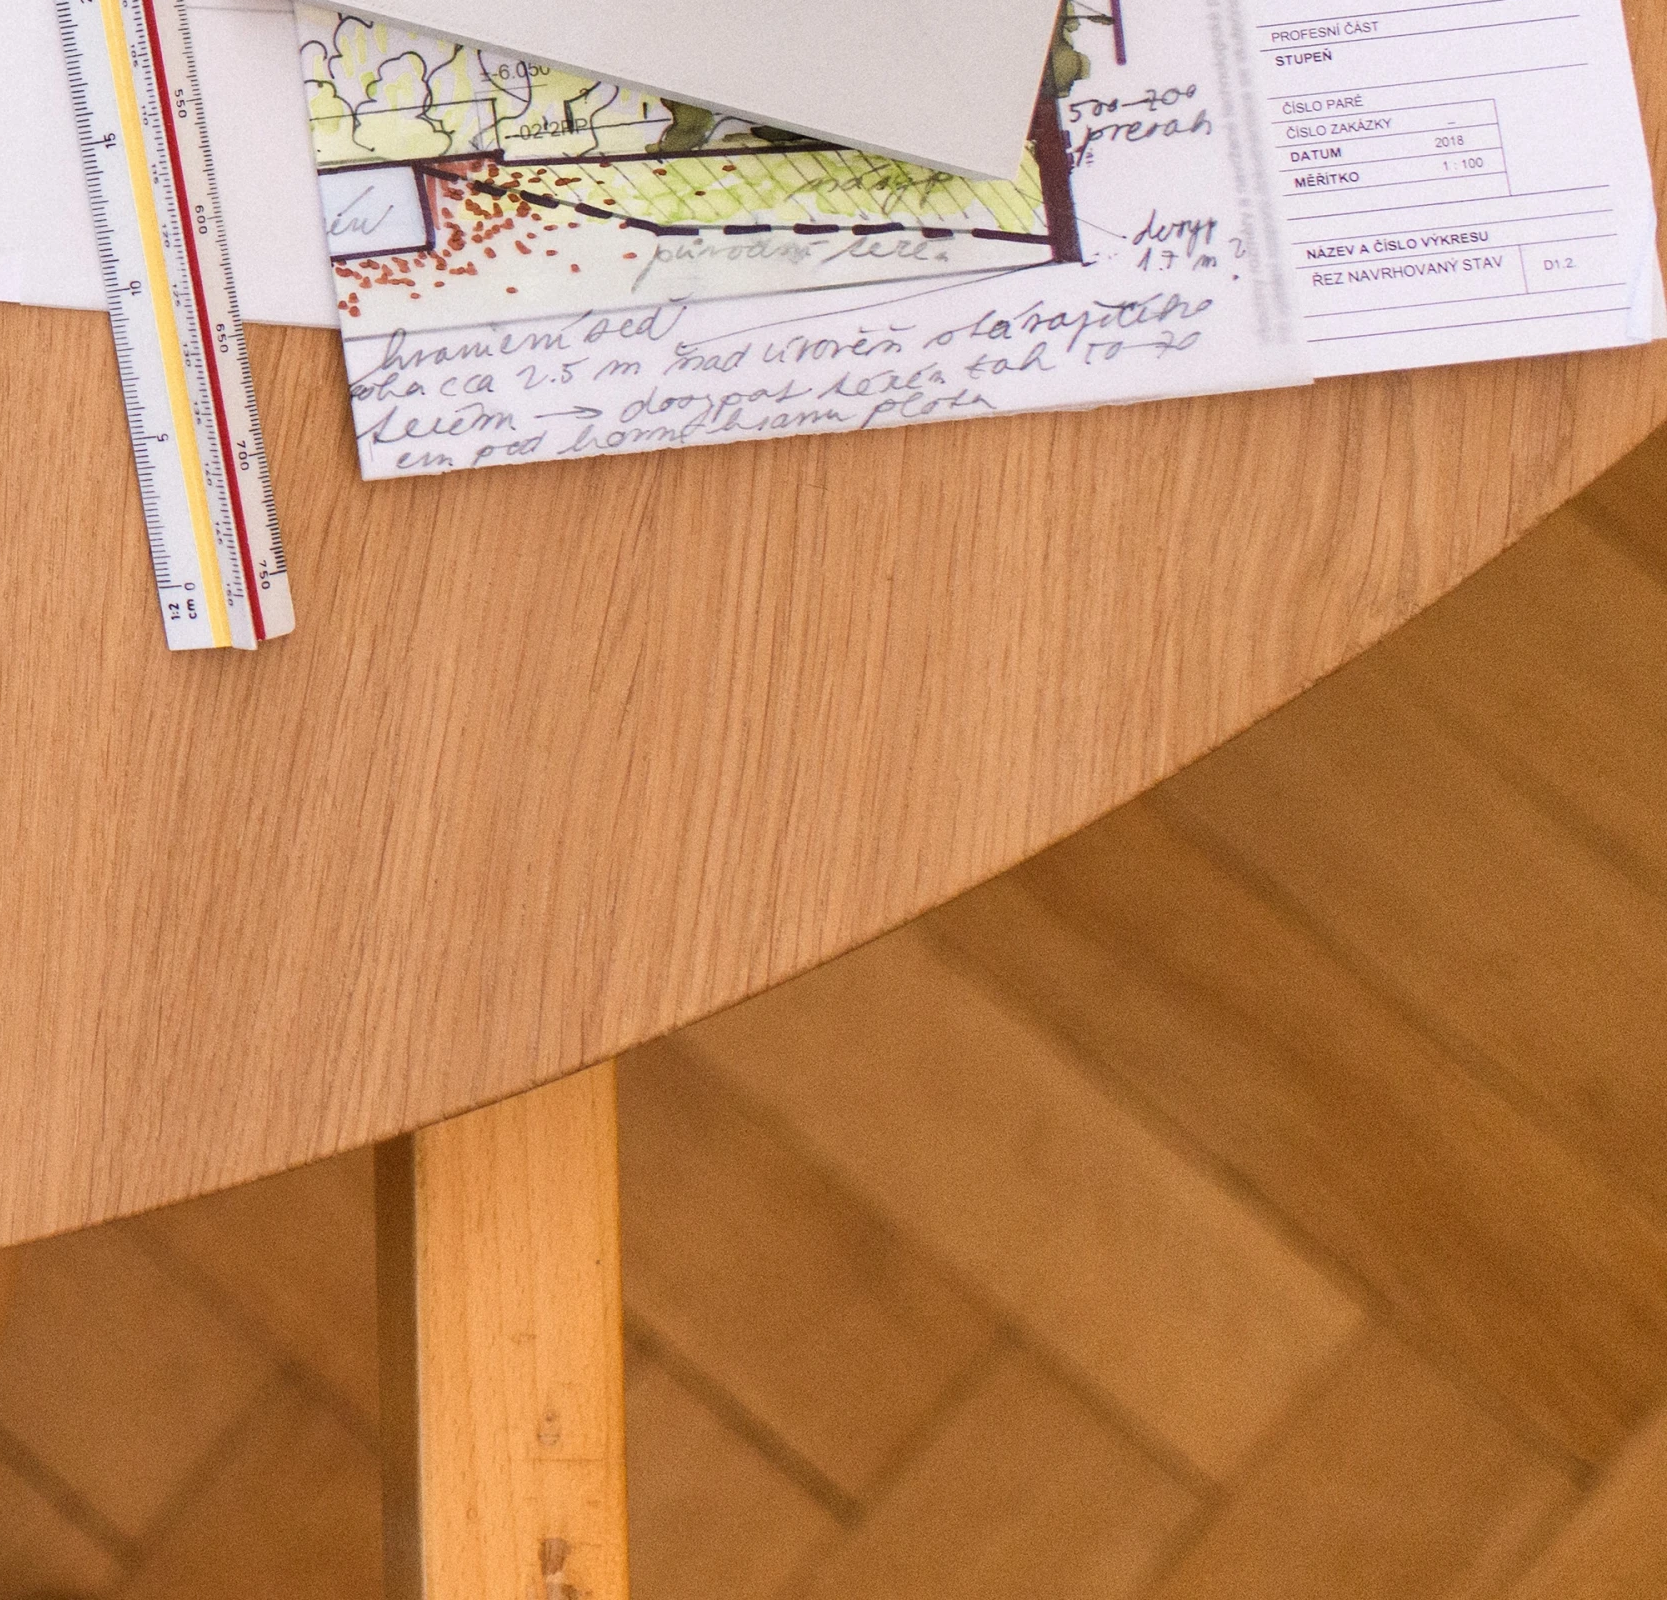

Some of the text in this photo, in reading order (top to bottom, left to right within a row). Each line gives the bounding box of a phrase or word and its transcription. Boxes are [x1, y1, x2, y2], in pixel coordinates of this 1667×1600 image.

[1271, 21, 1379, 43] PROFESNÍ ČÁST
[1275, 48, 1333, 66] STUPEŇ
[174, 89, 187, 118] 550
[1282, 94, 1364, 115] ČÍSLO PARÉ
[1286, 118, 1392, 139] ČÍSLO ZAKÁZKY
[104, 132, 117, 149] 15
[1435, 135, 1464, 148] 2018
[1290, 147, 1342, 163] DATUM
[1295, 171, 1360, 188] MĚŘÍTKO
[195, 205, 207, 235] 600
[1306, 230, 1489, 260] NÁZEV A ČÍSLO VÝKRESU
[1312, 255, 1503, 287] ŘEZ NAVRHOVANÝ STAV
[130, 280, 141, 296] 10
[216, 323, 228, 353] 650
[237, 440, 249, 471] 700
[259, 560, 271, 589] 750
[168, 602, 180, 620] 1:2
[188, 599, 197, 620] cm
